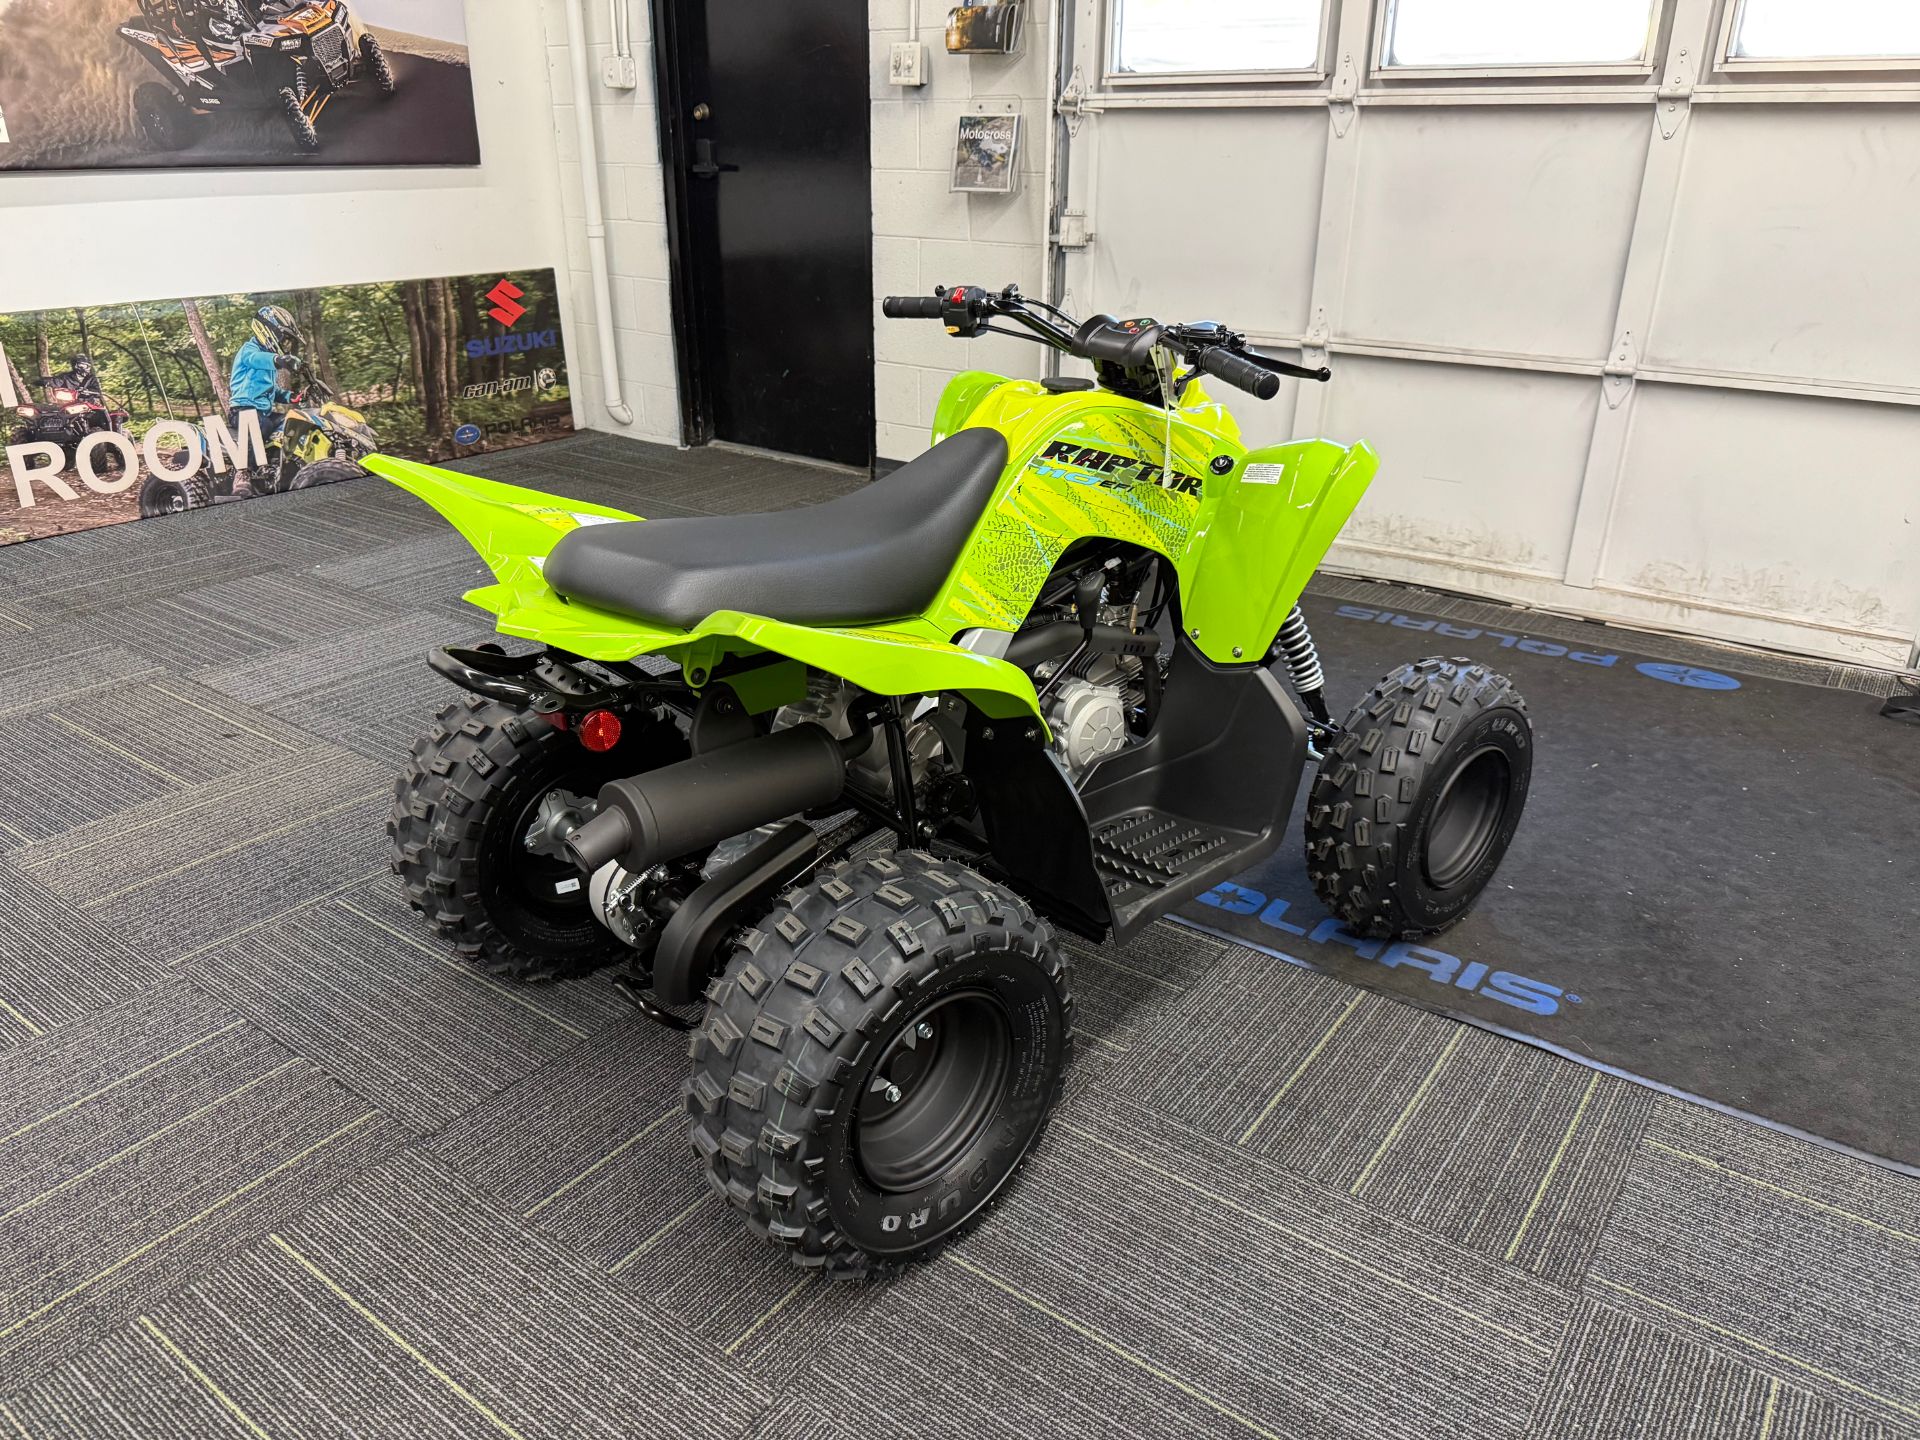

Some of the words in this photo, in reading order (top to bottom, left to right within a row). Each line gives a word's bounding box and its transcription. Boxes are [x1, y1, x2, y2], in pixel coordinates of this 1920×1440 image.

[960, 127, 1012, 140] Motocross
[466, 329, 557, 358] SUZUKI
[463, 375, 532, 399] can-am
[485, 413, 560, 436] POLARIS
[5, 409, 268, 508] ROOM
[1040, 440, 1203, 497] RAPTOR
[1099, 480, 1134, 493] EFI
[1334, 605, 1620, 667] POLARIS
[1195, 881, 1564, 1016] OLARIS
[882, 1158, 989, 1232] DURO
